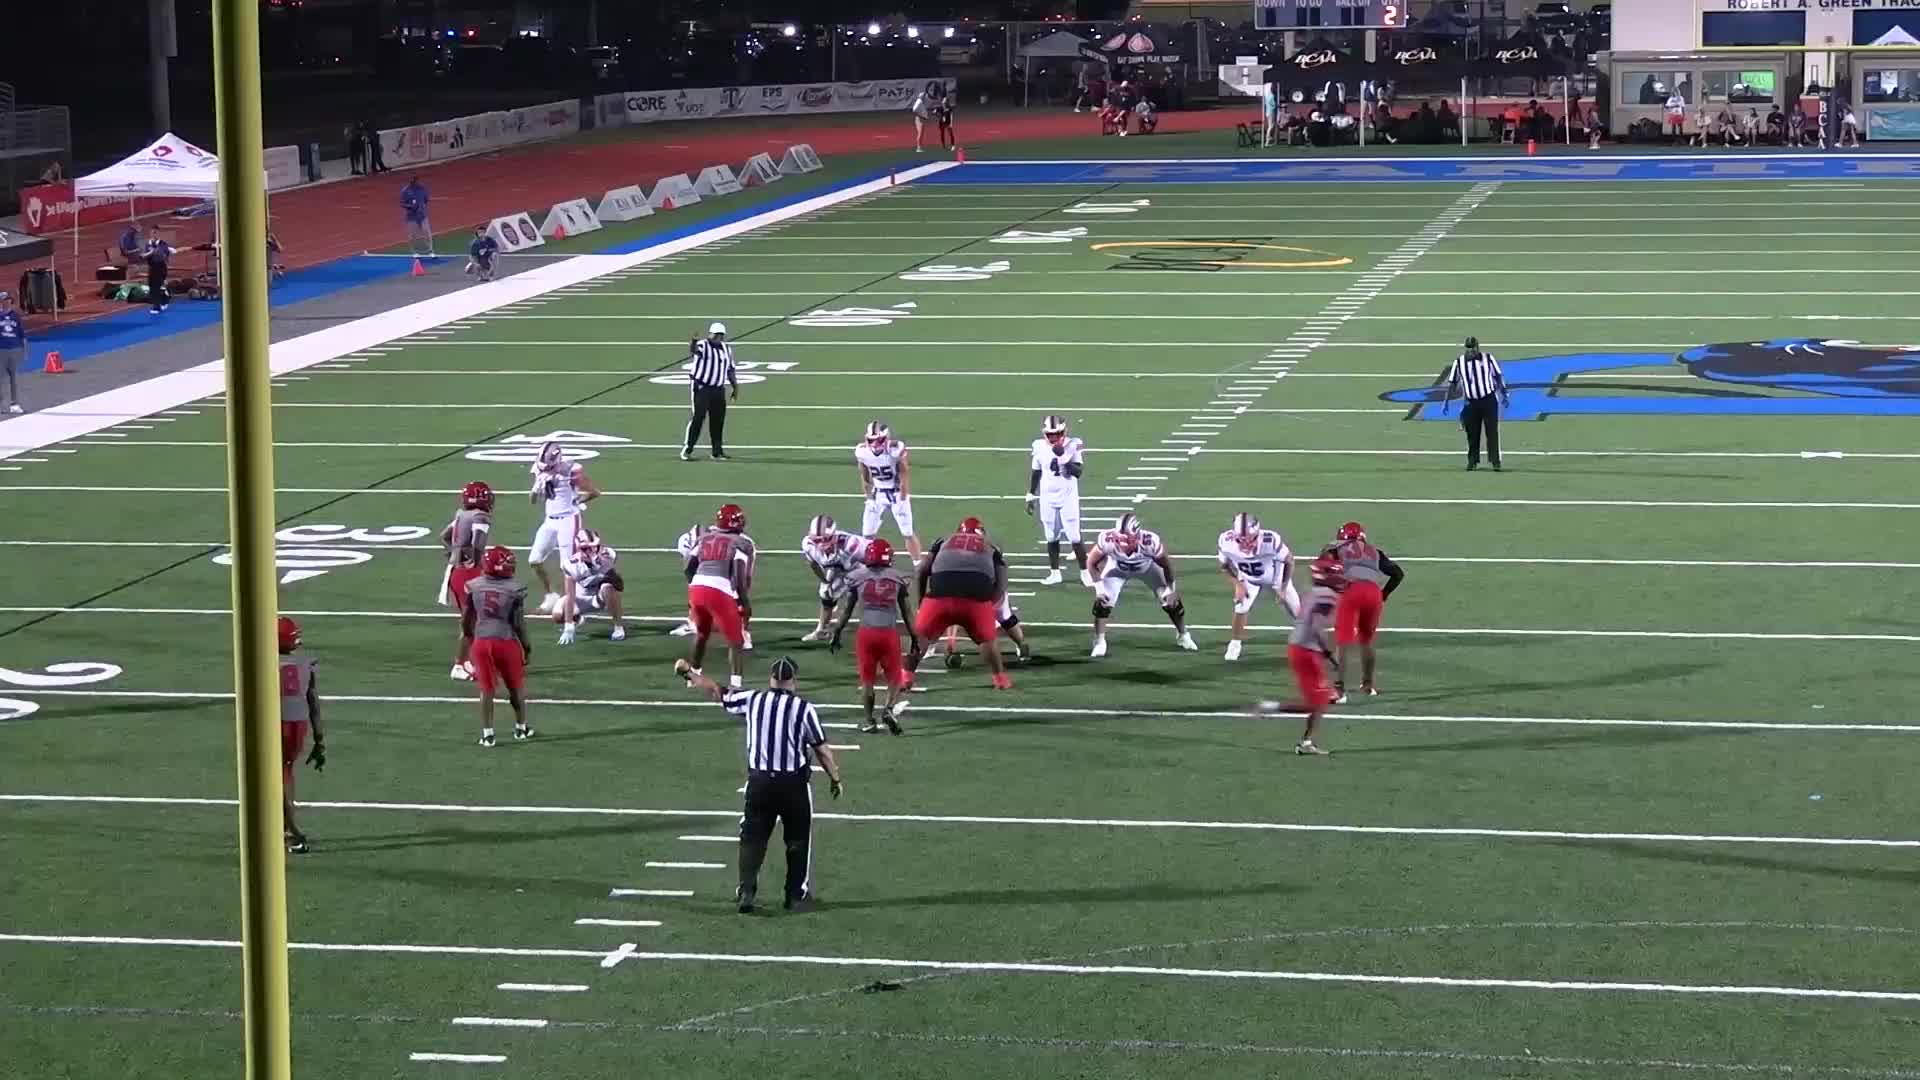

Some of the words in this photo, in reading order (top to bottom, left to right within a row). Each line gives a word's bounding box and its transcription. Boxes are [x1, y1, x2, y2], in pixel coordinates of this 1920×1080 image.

[1727, 0, 1788, 9] ROBERT
[1819, 0, 1872, 8] GREEN
[1384, 5, 1397, 25] 2
[762, 87, 783, 97] EPS
[627, 96, 667, 112] CORE
[869, 465, 894, 481] 25
[1049, 457, 1061, 477] 4
